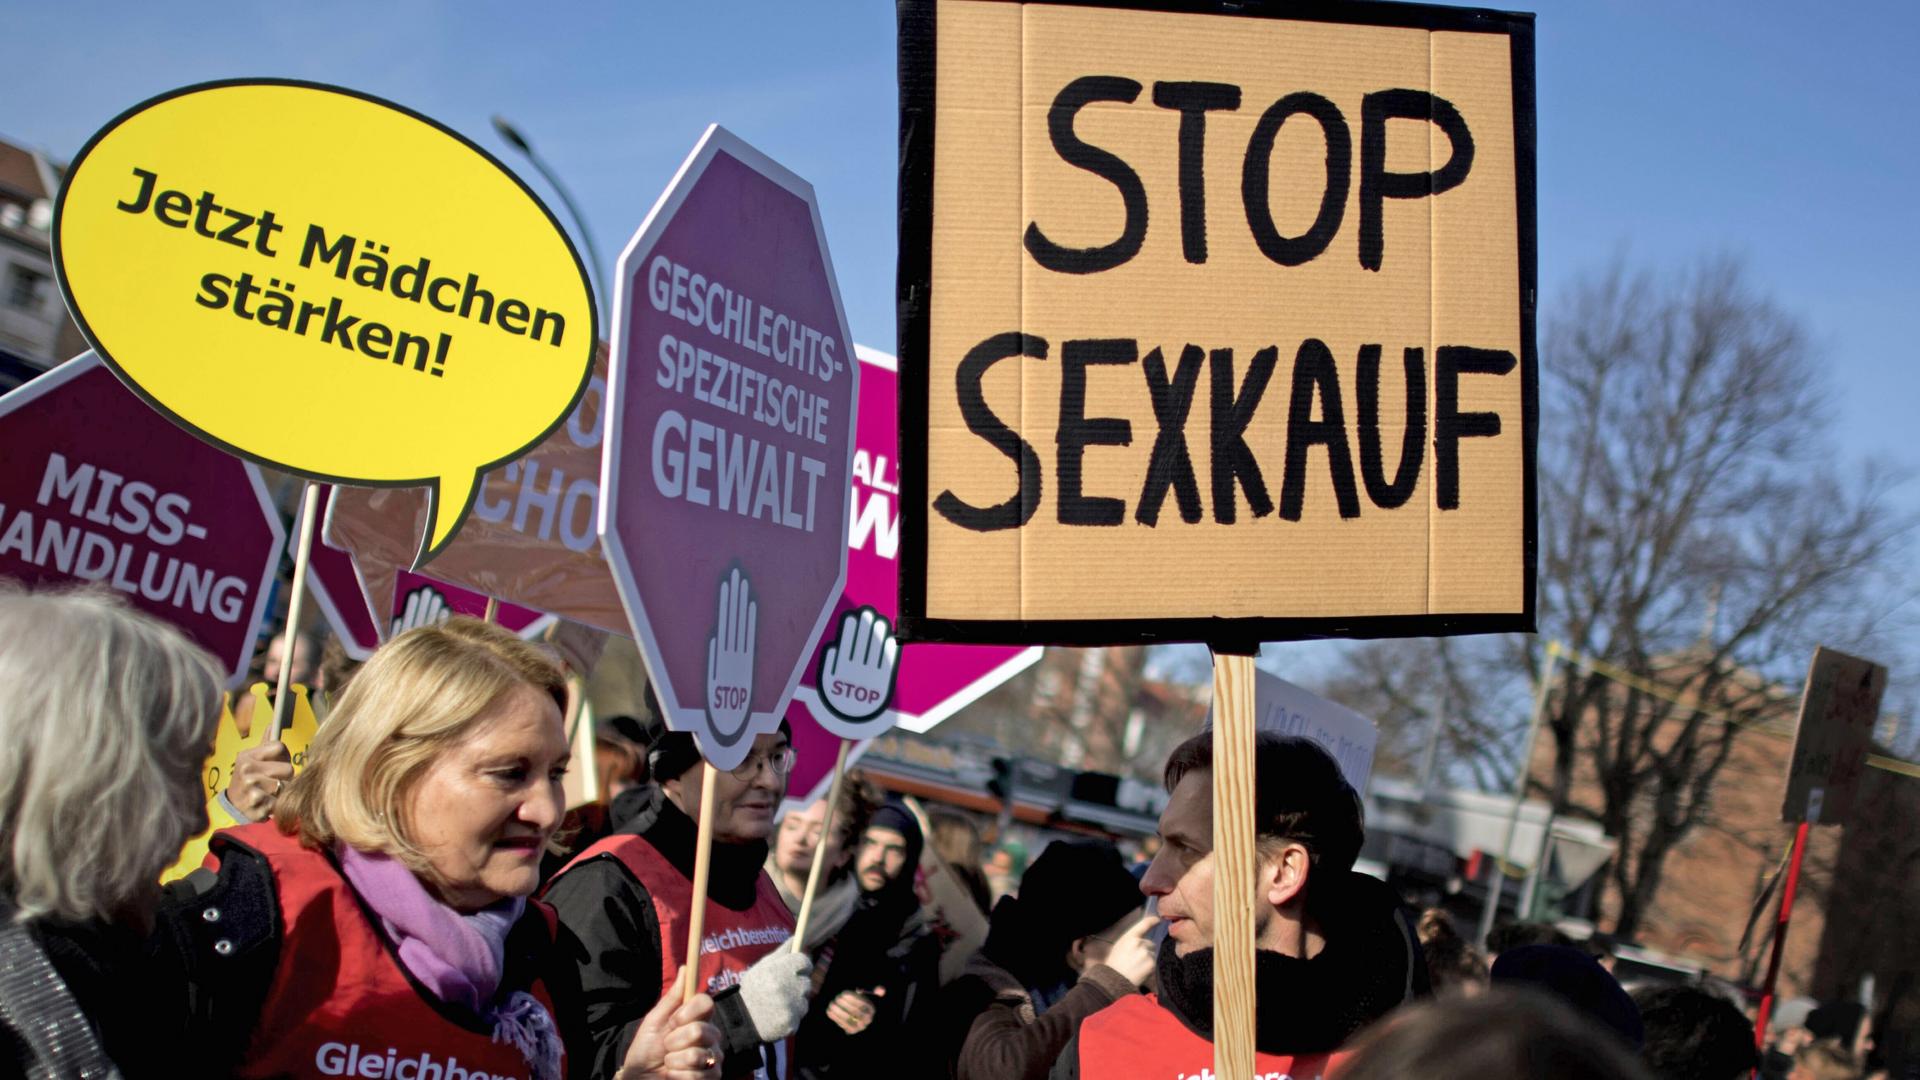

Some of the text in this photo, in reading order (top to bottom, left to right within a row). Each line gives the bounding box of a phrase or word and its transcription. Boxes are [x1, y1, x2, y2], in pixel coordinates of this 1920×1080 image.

[1023, 75, 1475, 275] STOP
[116, 167, 567, 348] Jetzt Mädchen
[195, 271, 453, 378] stärken!
[648, 255, 843, 382] GESCHLECHTS-
[656, 333, 829, 445] SPEZIFISCHE
[932, 332, 1518, 531] SEXKAUF
[36, 452, 207, 546] MISS-
[651, 409, 826, 533] GEWALT
[0, 503, 248, 623] ANDLUNG
[714, 685, 747, 710] STOP
[831, 680, 880, 705] STOP
